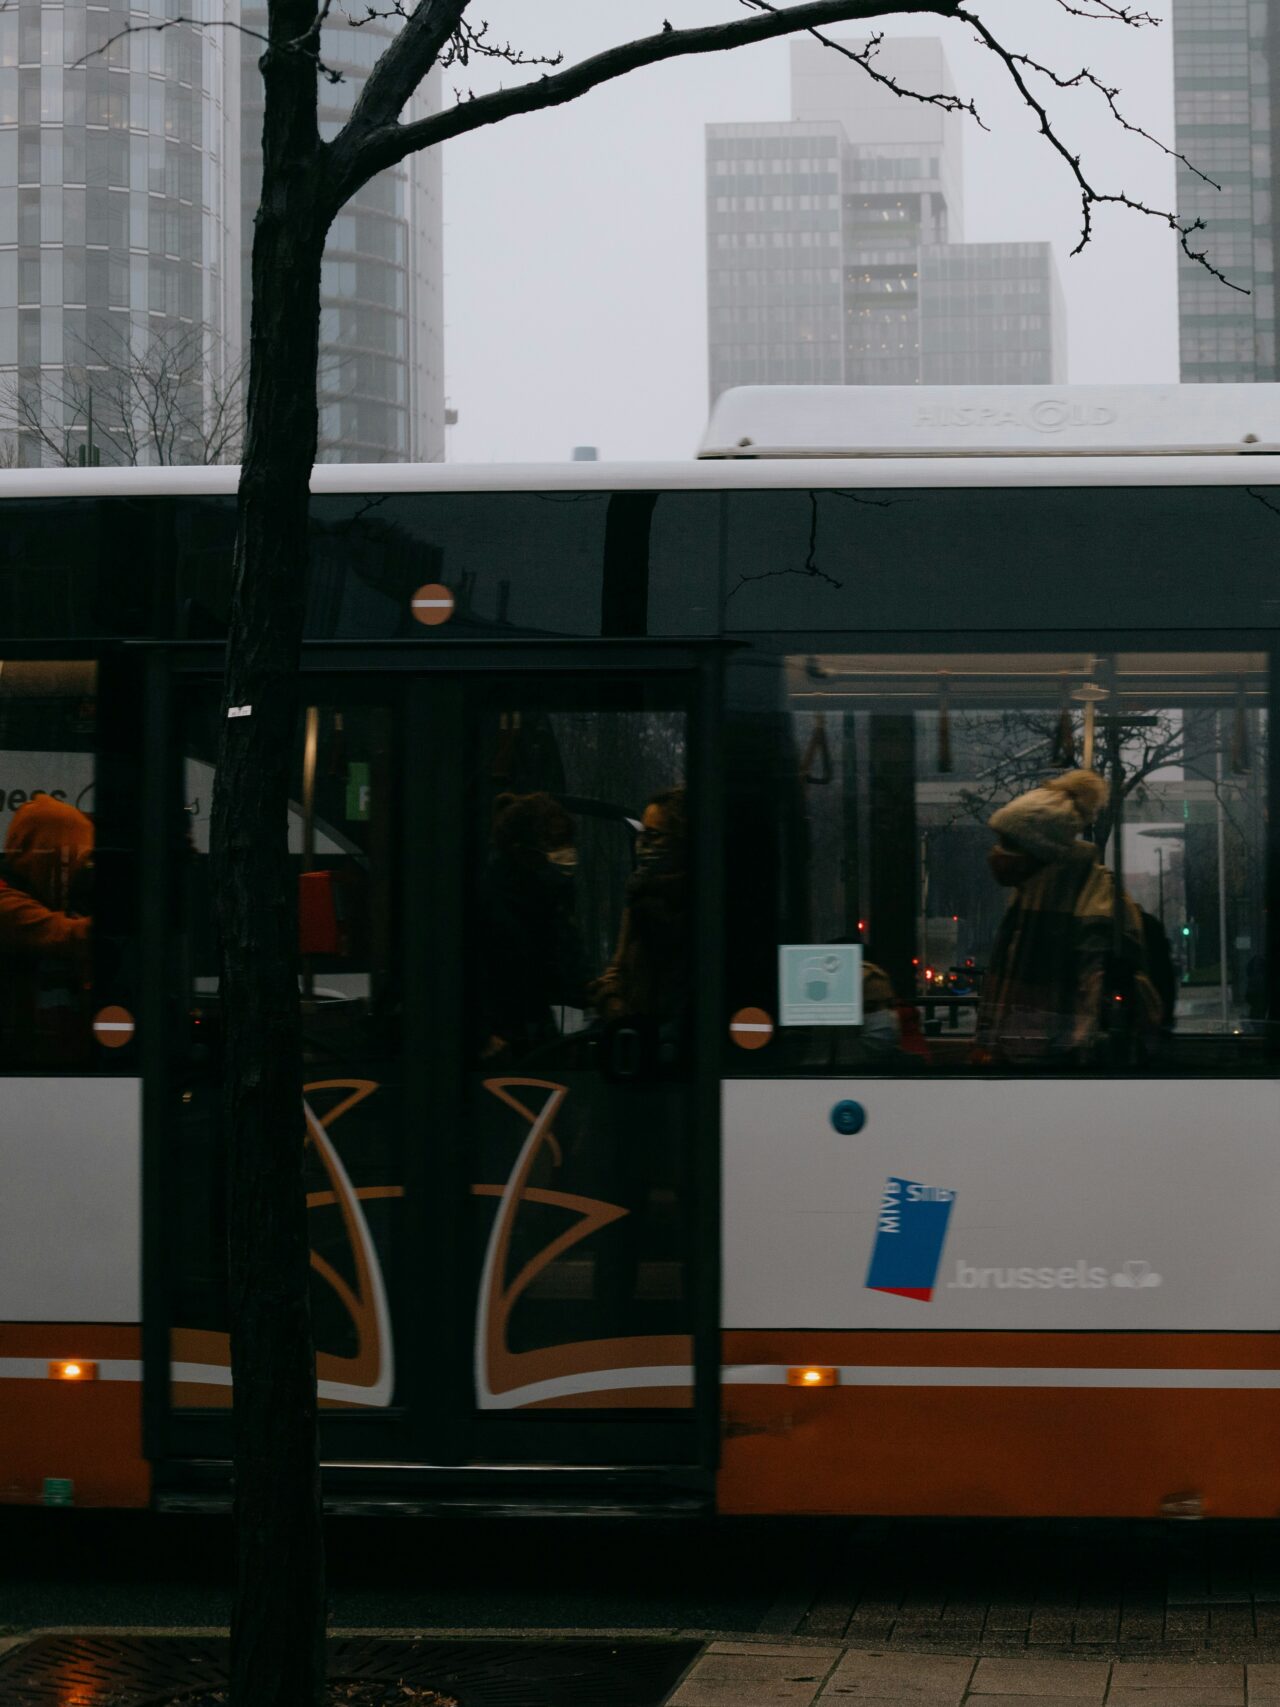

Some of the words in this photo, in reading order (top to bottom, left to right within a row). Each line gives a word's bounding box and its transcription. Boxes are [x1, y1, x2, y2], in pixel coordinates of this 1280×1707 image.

[912, 399, 1117, 433] HISPACOLD
[880, 1181, 902, 1234] MIVB
[905, 1184, 955, 1203] STIB
